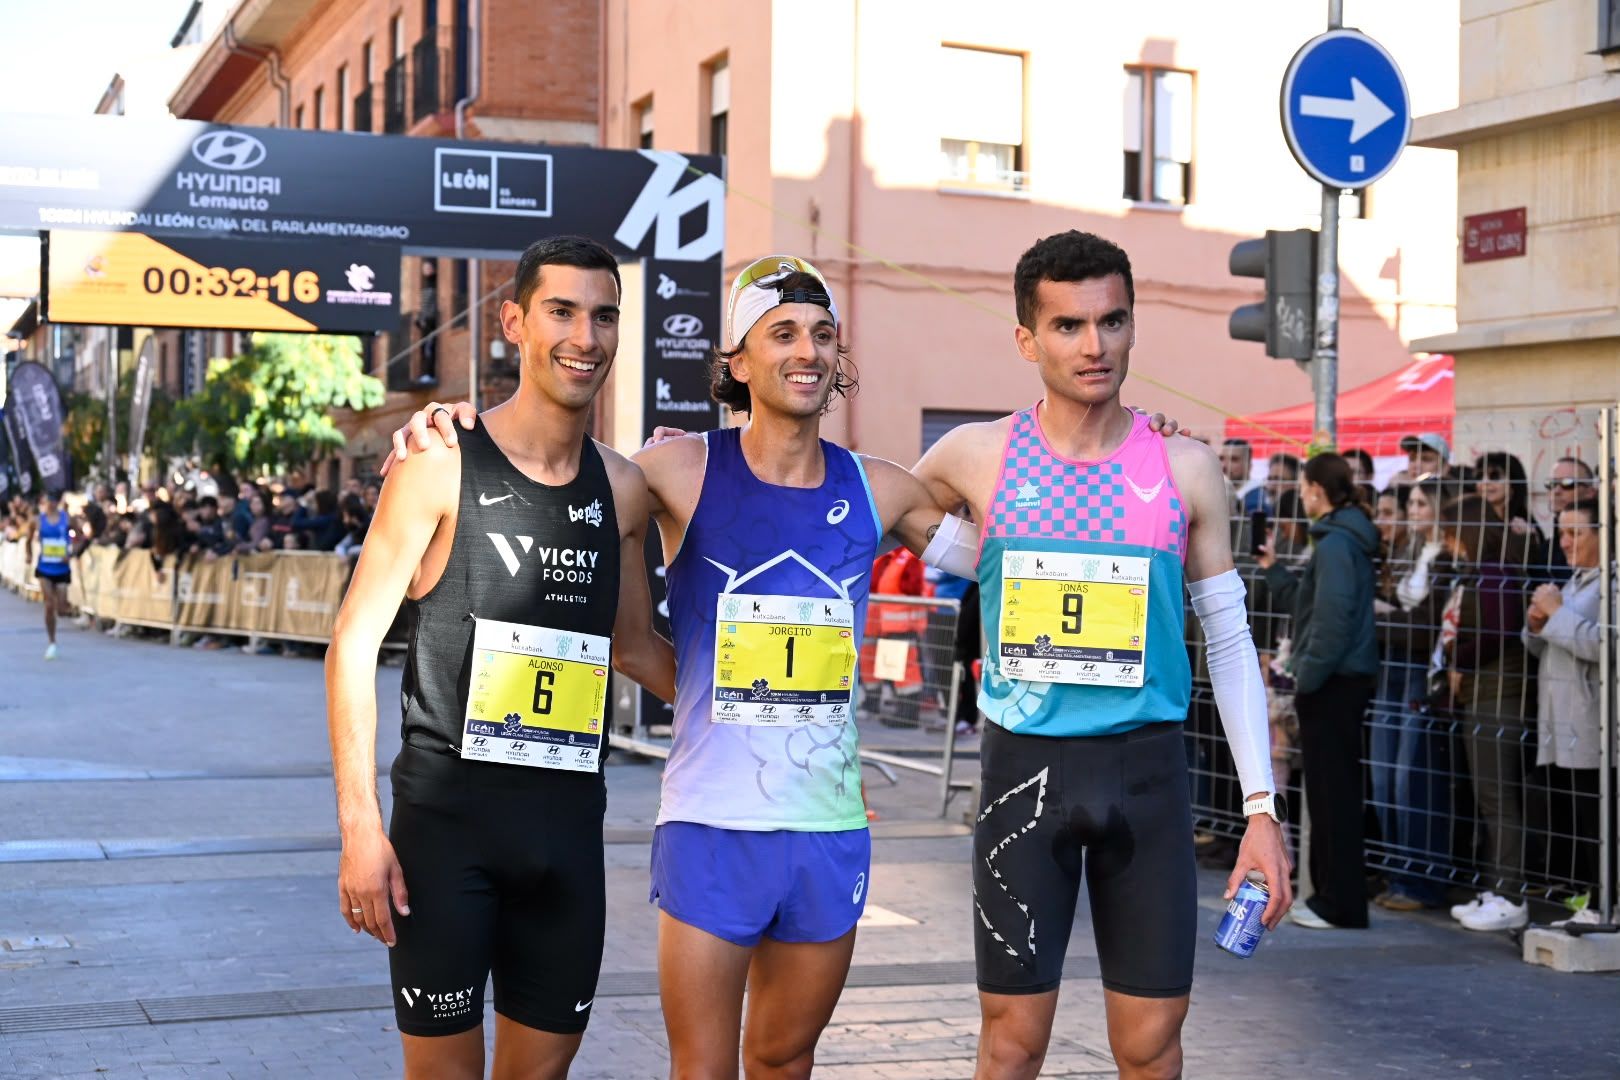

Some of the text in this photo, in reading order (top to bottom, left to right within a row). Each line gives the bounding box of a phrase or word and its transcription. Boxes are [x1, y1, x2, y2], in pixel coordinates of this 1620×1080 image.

[177, 172, 281, 194] HYUNDAI
[443, 168, 489, 190] LEÓN
[189, 192, 269, 212] Lemauto
[156, 211, 194, 228] LEÓN
[196, 215, 239, 231] CUNA
[242, 219, 269, 233] DEL
[272, 219, 410, 240] PARLAMENTARISMO
[143, 266, 320, 304] 00:32:16
[655, 337, 710, 350] HYUNDAI
[656, 377, 671, 400] k
[656, 400, 710, 412] kutxabank
[1015, 500, 1041, 508] luanvi
[539, 546, 599, 568] VICKY
[543, 568, 592, 584] FOODS
[1057, 583, 1089, 593] JONÁS
[545, 593, 587, 604] ATHLETICS
[1061, 593, 1083, 635] 9
[768, 627, 812, 637] JORGITO
[581, 640, 589, 652] k
[528, 659, 564, 672] ALONSO
[785, 637, 795, 678] 1
[532, 670, 555, 715] 6
[427, 986, 474, 1003] VICKY
[433, 998, 471, 1011] FOODS
[433, 1007, 471, 1018] ATHLETICS
